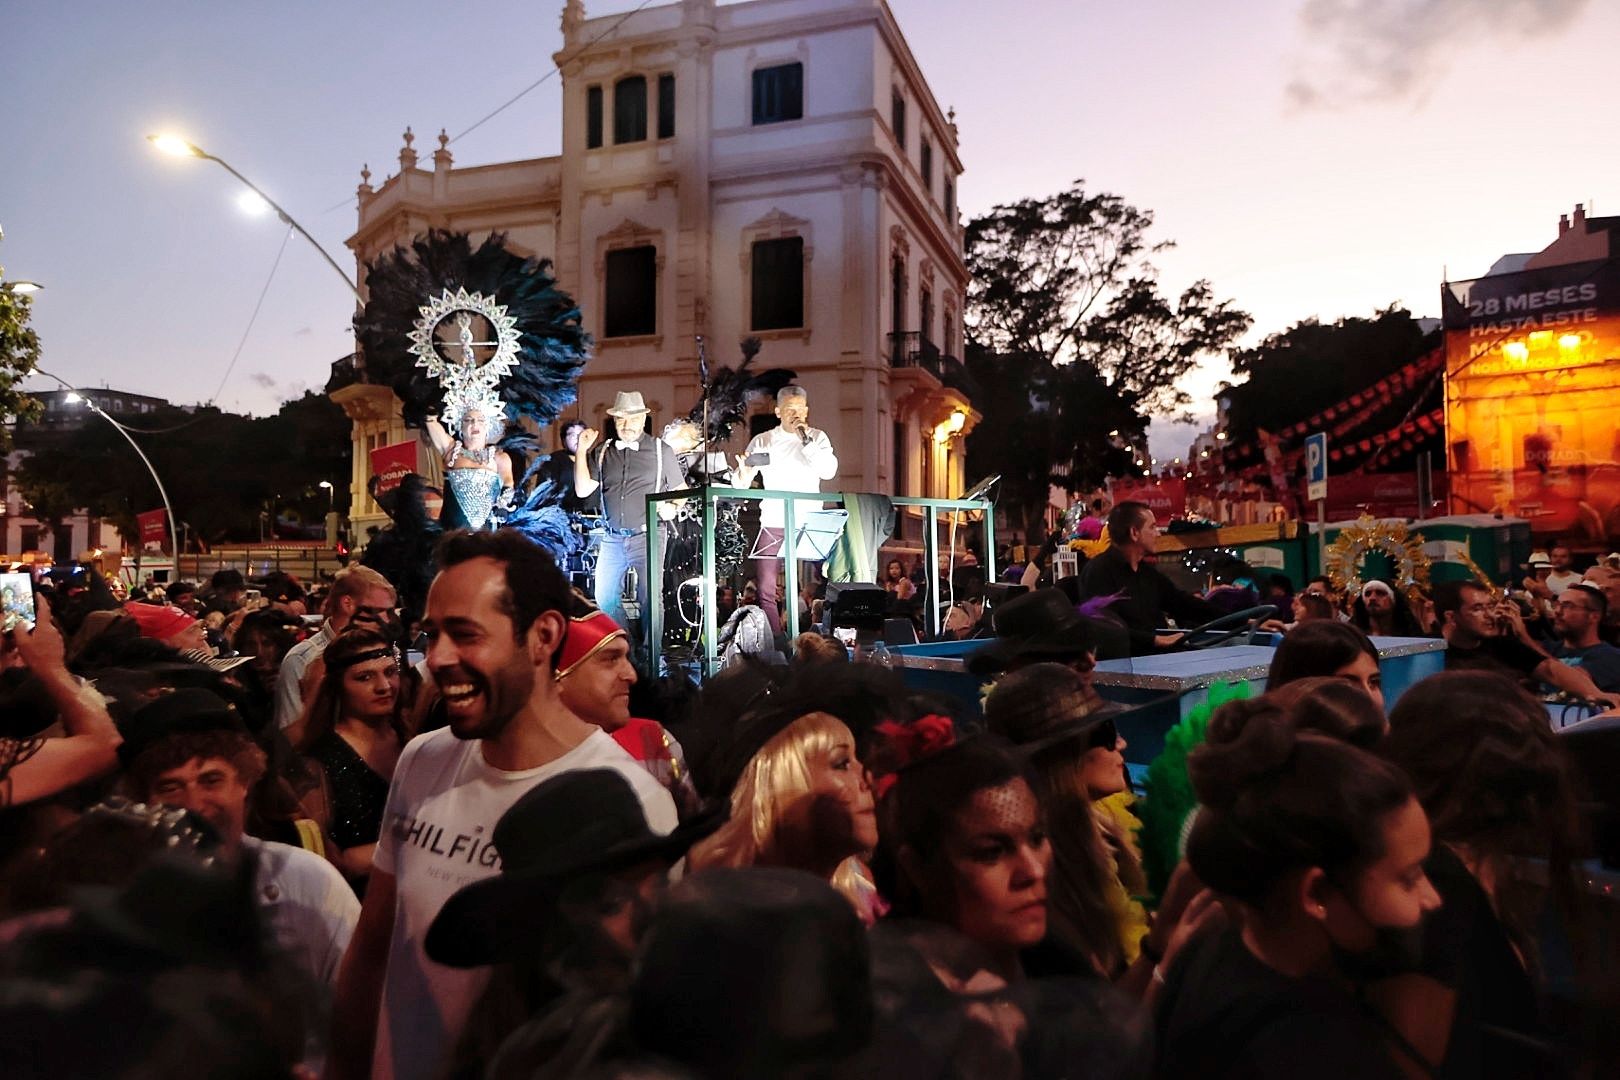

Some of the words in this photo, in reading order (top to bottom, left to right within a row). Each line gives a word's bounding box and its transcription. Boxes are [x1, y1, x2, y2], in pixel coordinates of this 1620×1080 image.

[1469, 299, 1500, 318] 28
[1505, 284, 1598, 313] MESES
[1469, 315, 1538, 338] HASTA
[1542, 308, 1598, 327] ESTE
[1308, 443, 1320, 480] P
[407, 819, 503, 870] HILFIG
